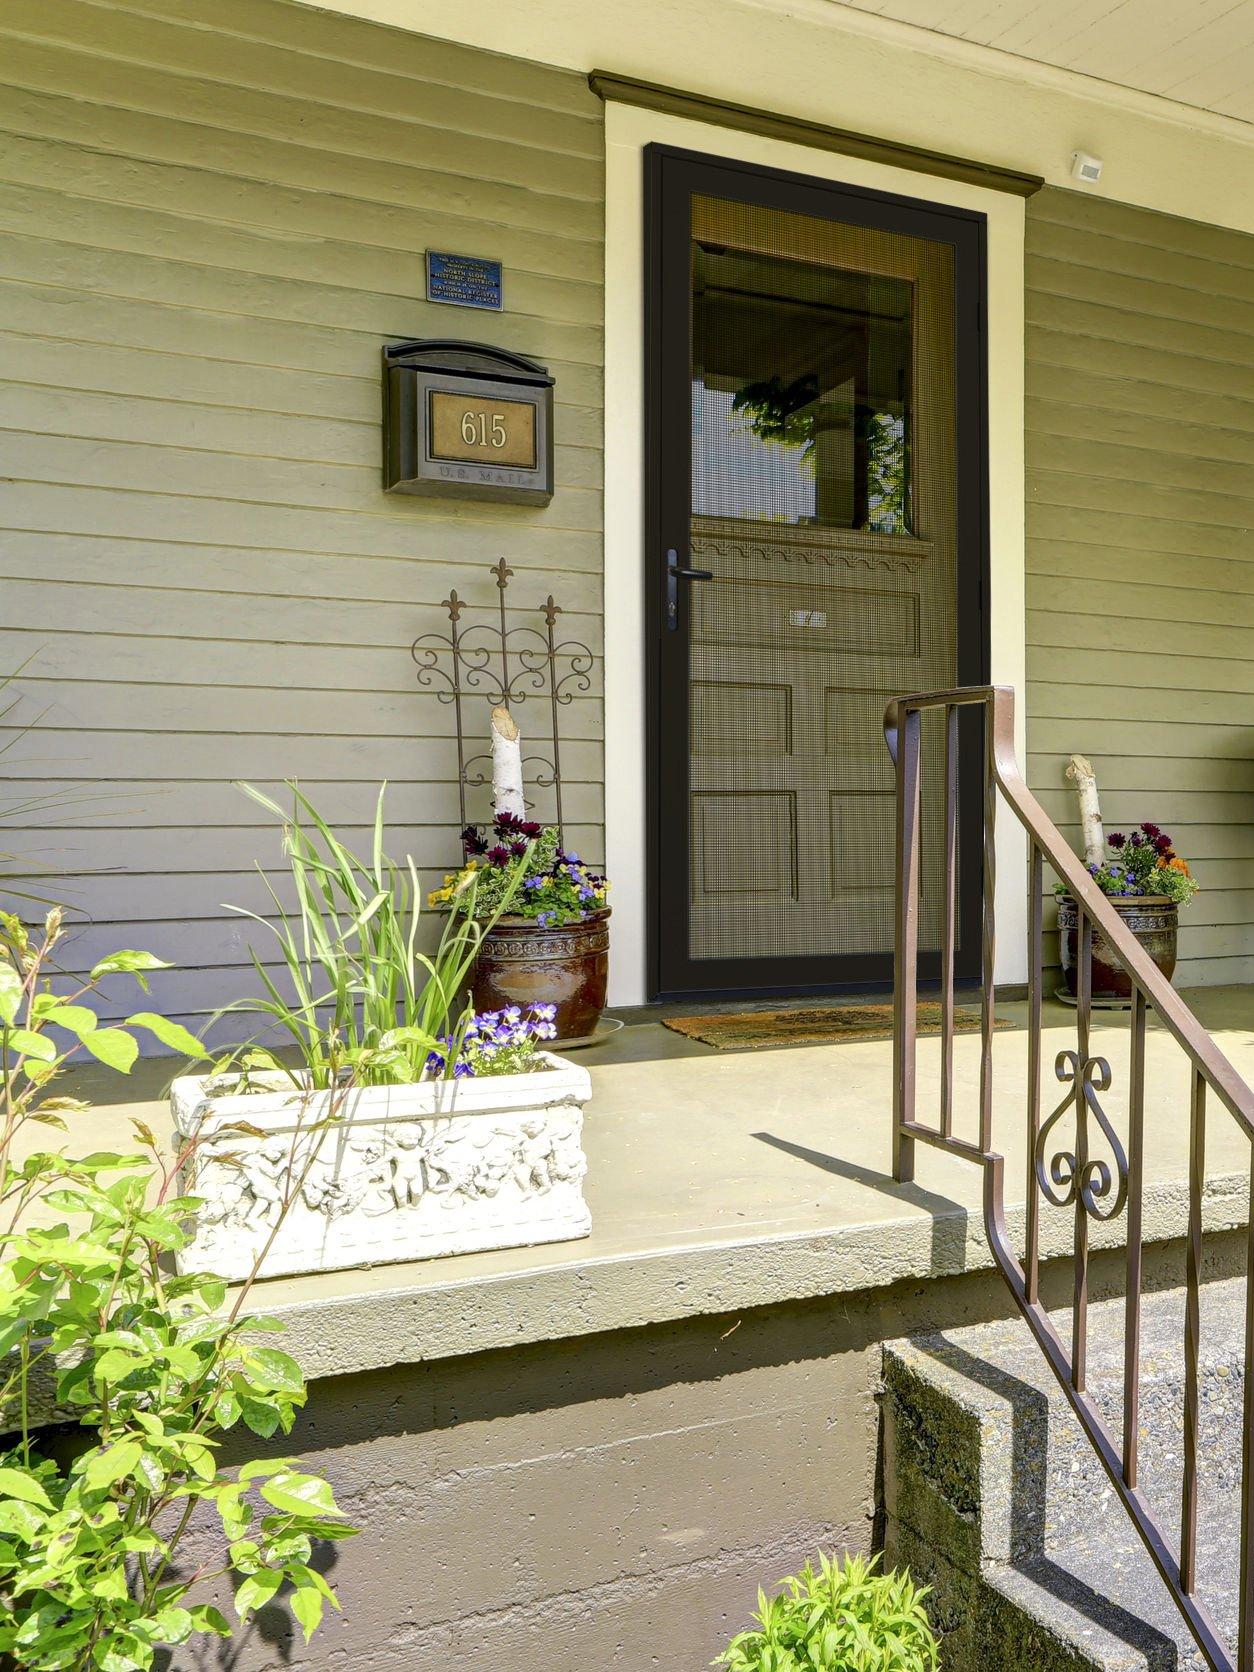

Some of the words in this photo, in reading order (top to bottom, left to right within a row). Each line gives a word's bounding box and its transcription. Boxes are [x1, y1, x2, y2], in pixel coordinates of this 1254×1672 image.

[434, 272, 465, 280] HISTORIC
[467, 277, 496, 285] DISTRICT
[433, 284, 466, 293] NATIONAL
[443, 291, 473, 299] HISTORIC
[460, 411, 507, 448] 615
[480, 471, 527, 485] MAIL
